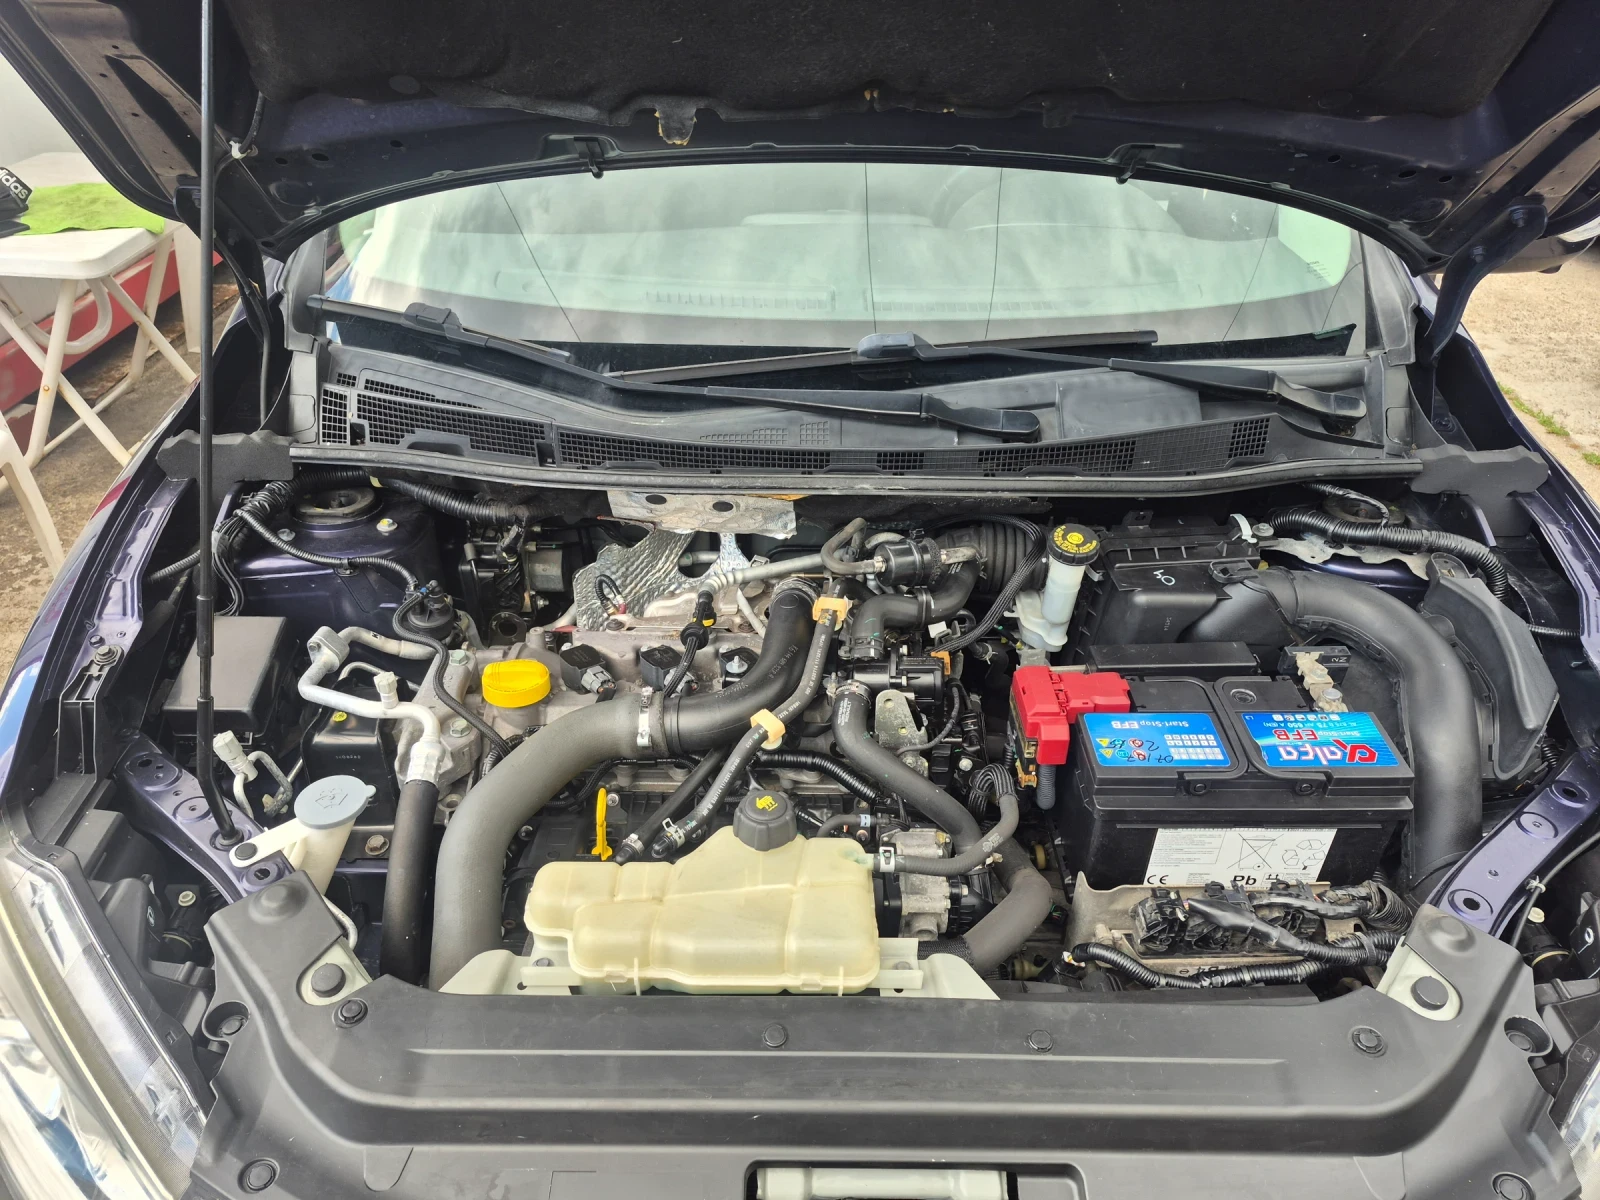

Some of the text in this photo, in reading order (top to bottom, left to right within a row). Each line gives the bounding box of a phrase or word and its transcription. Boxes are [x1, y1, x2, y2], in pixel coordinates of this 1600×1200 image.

[0, 169, 28, 199] idas
[1111, 720, 1189, 729] Start-Stop EFB
[1273, 729, 1318, 741] EFB
[1278, 743, 1342, 765] alfa
[1233, 875, 1257, 885] Pb
